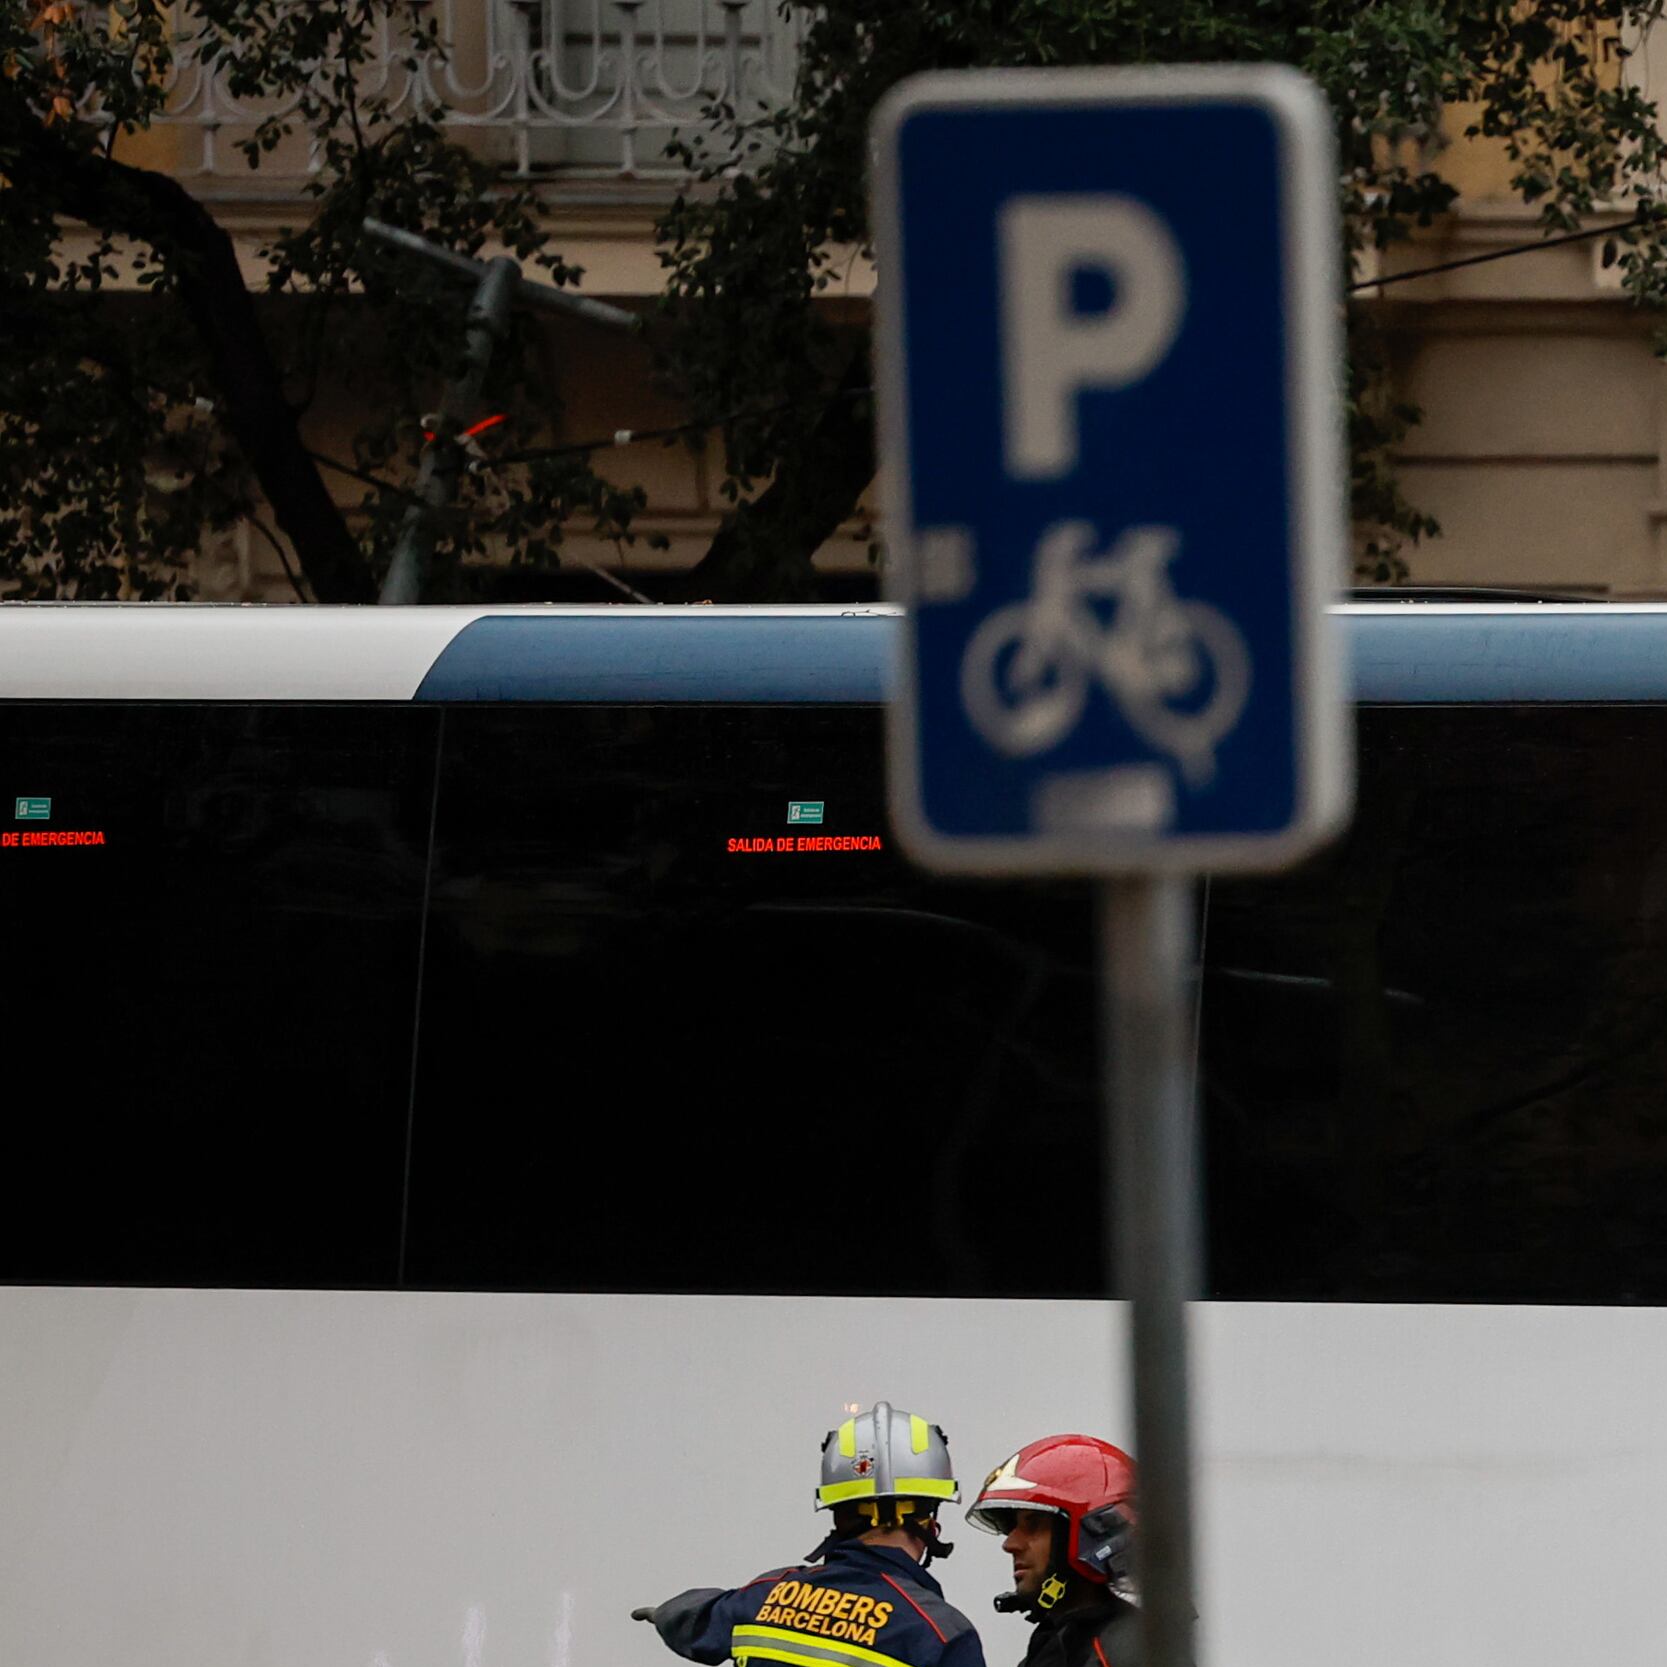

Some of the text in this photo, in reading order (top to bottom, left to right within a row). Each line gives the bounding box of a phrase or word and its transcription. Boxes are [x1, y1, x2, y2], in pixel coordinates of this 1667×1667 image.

[1000, 195, 1188, 478] P
[2, 831, 105, 847] DE EMERGENCIA
[727, 836, 882, 852] SALIDA DE EMERGENCIA
[755, 1604, 878, 1647] BARCELONA
[764, 1580, 894, 1629] BOMBERS
